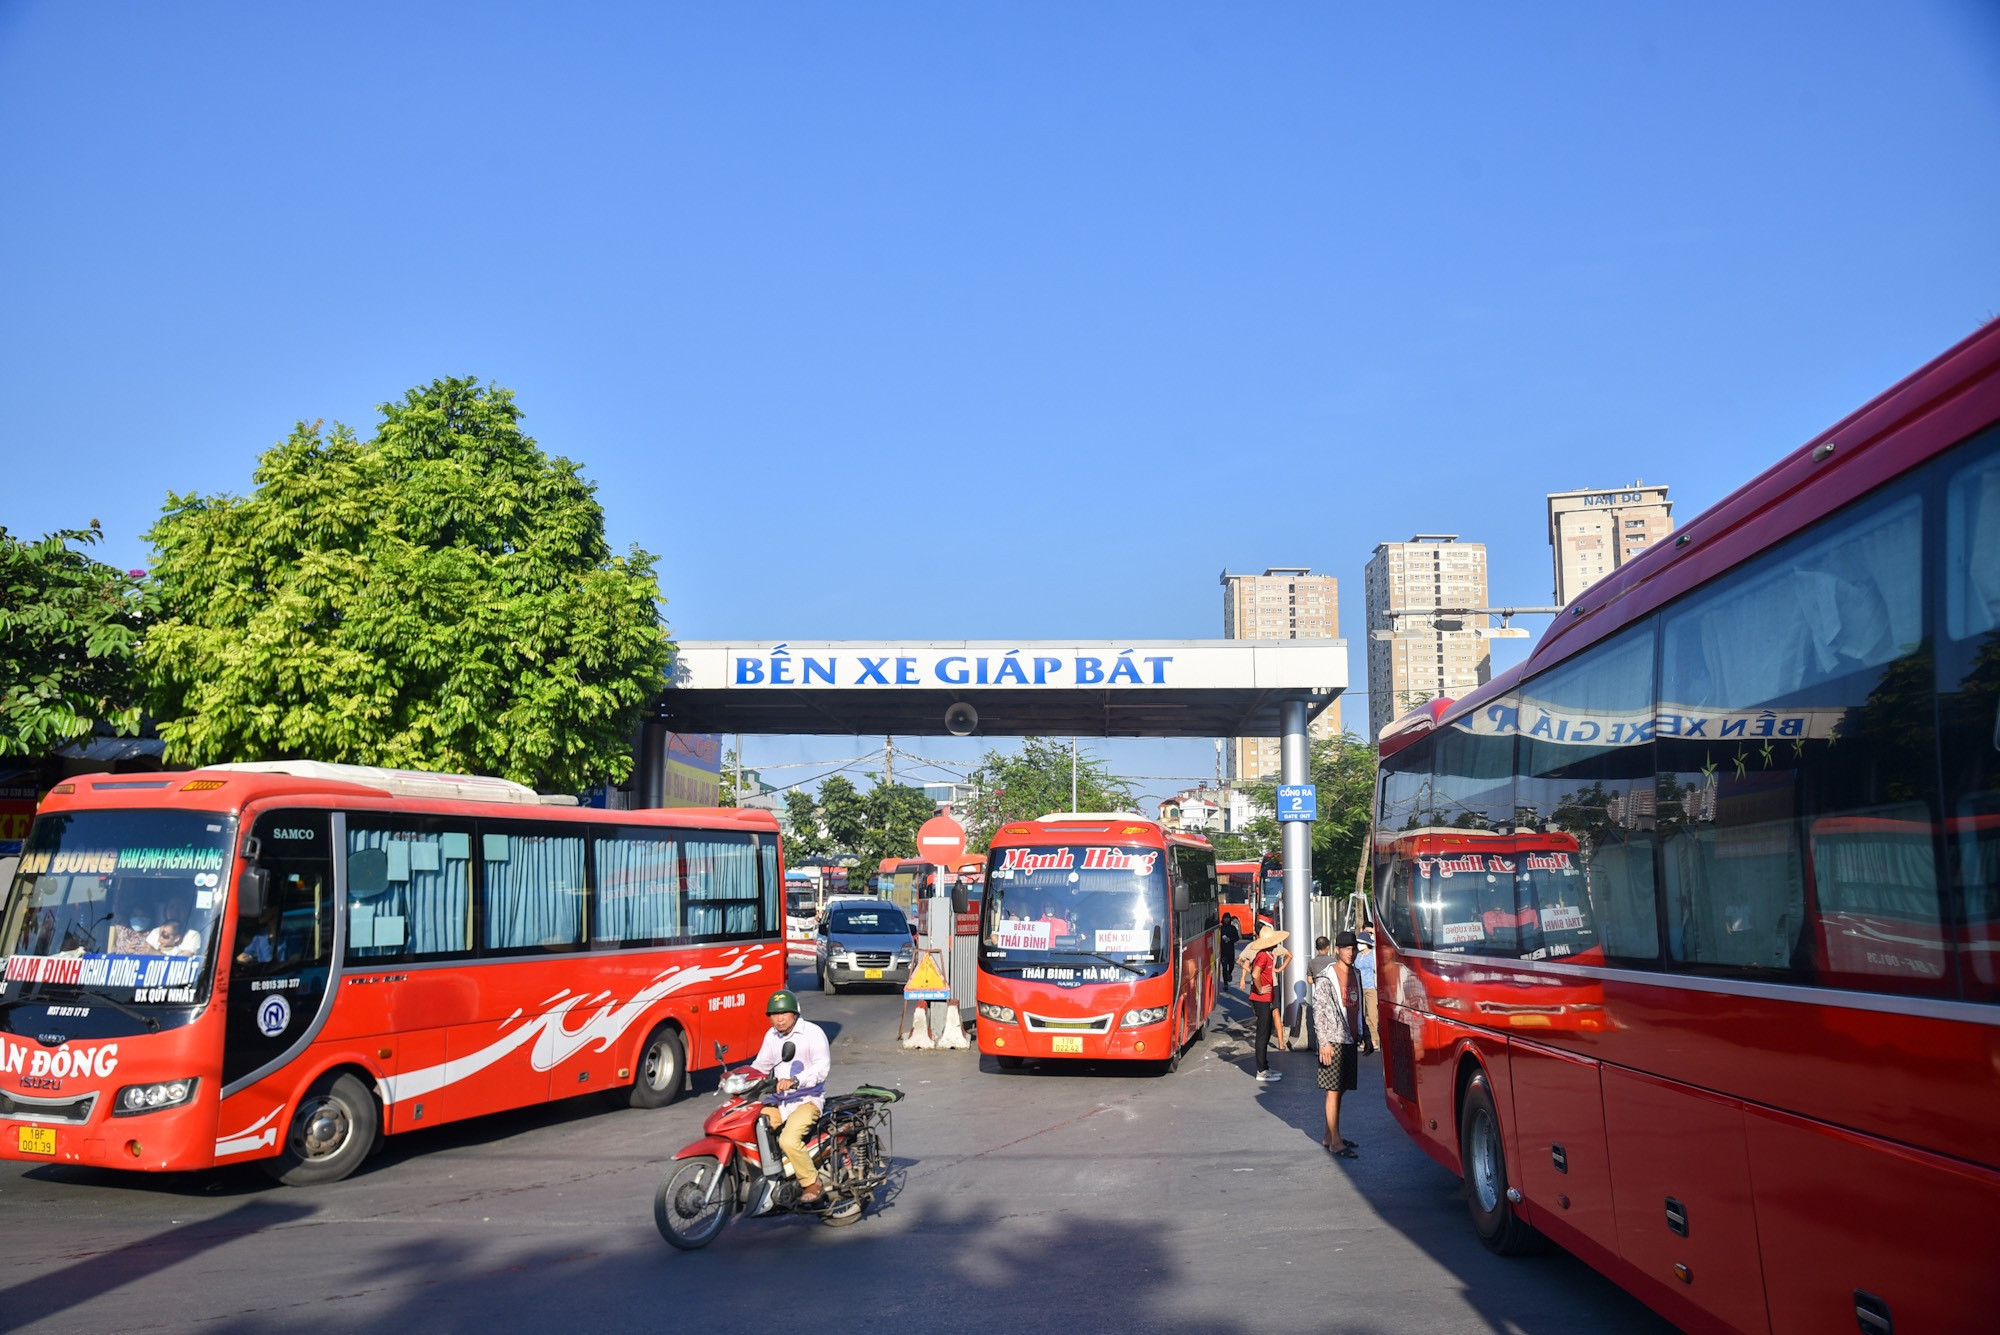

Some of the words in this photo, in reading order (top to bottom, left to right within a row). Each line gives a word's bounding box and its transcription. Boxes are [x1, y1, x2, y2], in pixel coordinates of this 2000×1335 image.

[1584, 494, 1616, 506] NAM
[736, 643, 837, 685] BẾN
[854, 657, 921, 685] XE
[934, 648, 1062, 685] GIÁP
[1074, 648, 1174, 685] BÁT
[1301, 789, 1313, 797] RA
[1292, 797, 1303, 811] 2
[273, 828, 314, 840] SAMCO
[999, 847, 1075, 875] Mạnh
[1080, 847, 1158, 875] Hùng
[1000, 934, 1022, 948] THÁI
[1023, 935, 1046, 949] BÌNH
[6, 957, 39, 981] NAM
[166, 956, 200, 985] NHẤT
[1022, 967, 1045, 979] THÁI
[1083, 966, 1098, 980] HÀ
[1100, 965, 1119, 981] NỘI
[134, 988, 149, 1002] BX
[167, 984, 196, 1002] NHẤT
[708, 993, 746, 1012] 18F-001.39
[29, 1043, 118, 1077] ĐÔNG
[20, 1076, 62, 1090] ISUZU
[30, 1129, 45, 1140] 18F
[22, 1140, 51, 1152] 001.39
